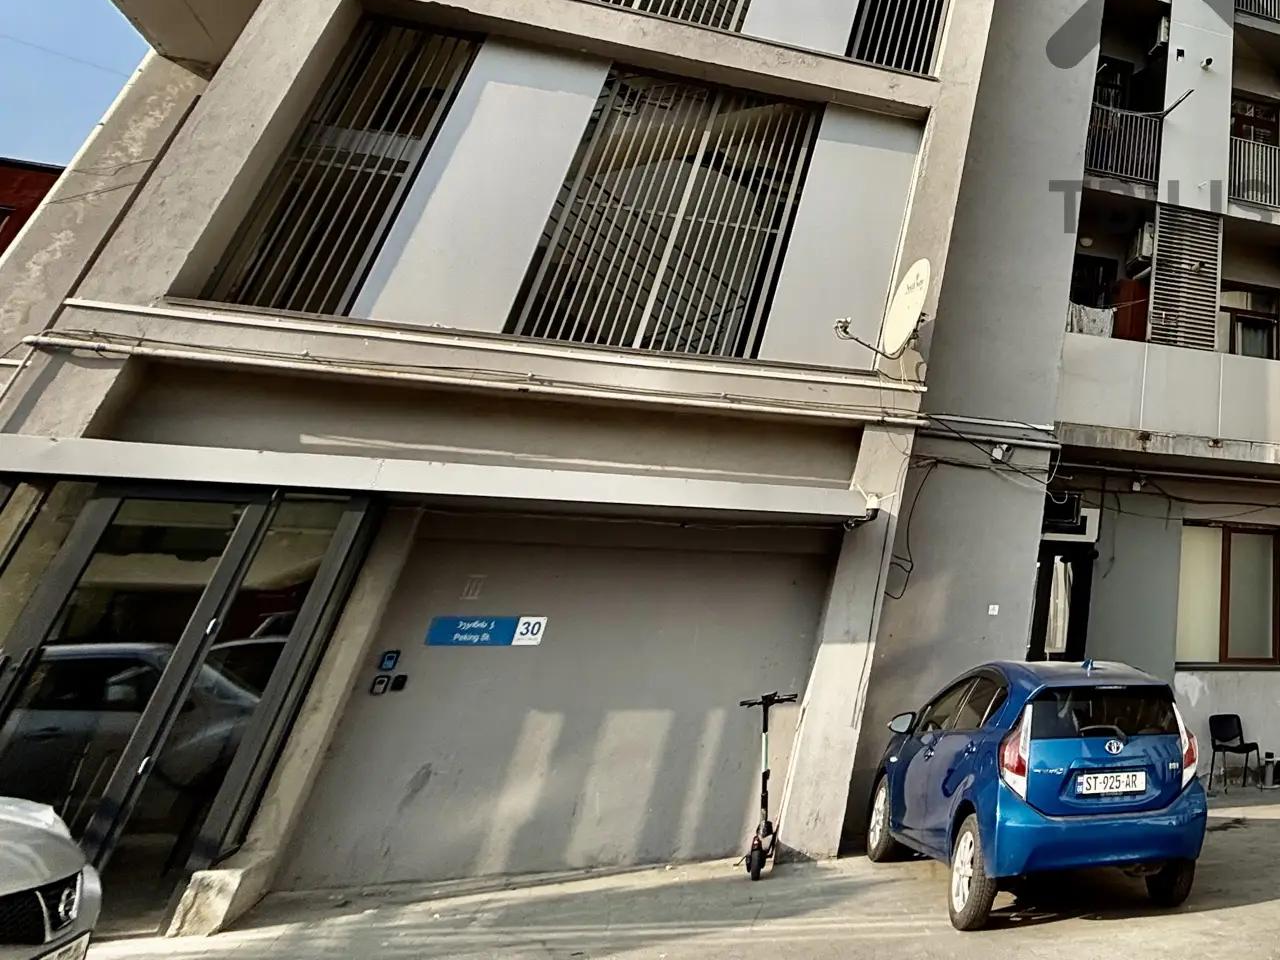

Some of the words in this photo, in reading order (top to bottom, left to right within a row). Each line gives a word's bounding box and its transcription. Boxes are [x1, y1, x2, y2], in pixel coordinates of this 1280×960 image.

[519, 621, 542, 637] 30
[452, 632, 480, 644] Peking
[1085, 774, 1137, 791] ST-925-AR
